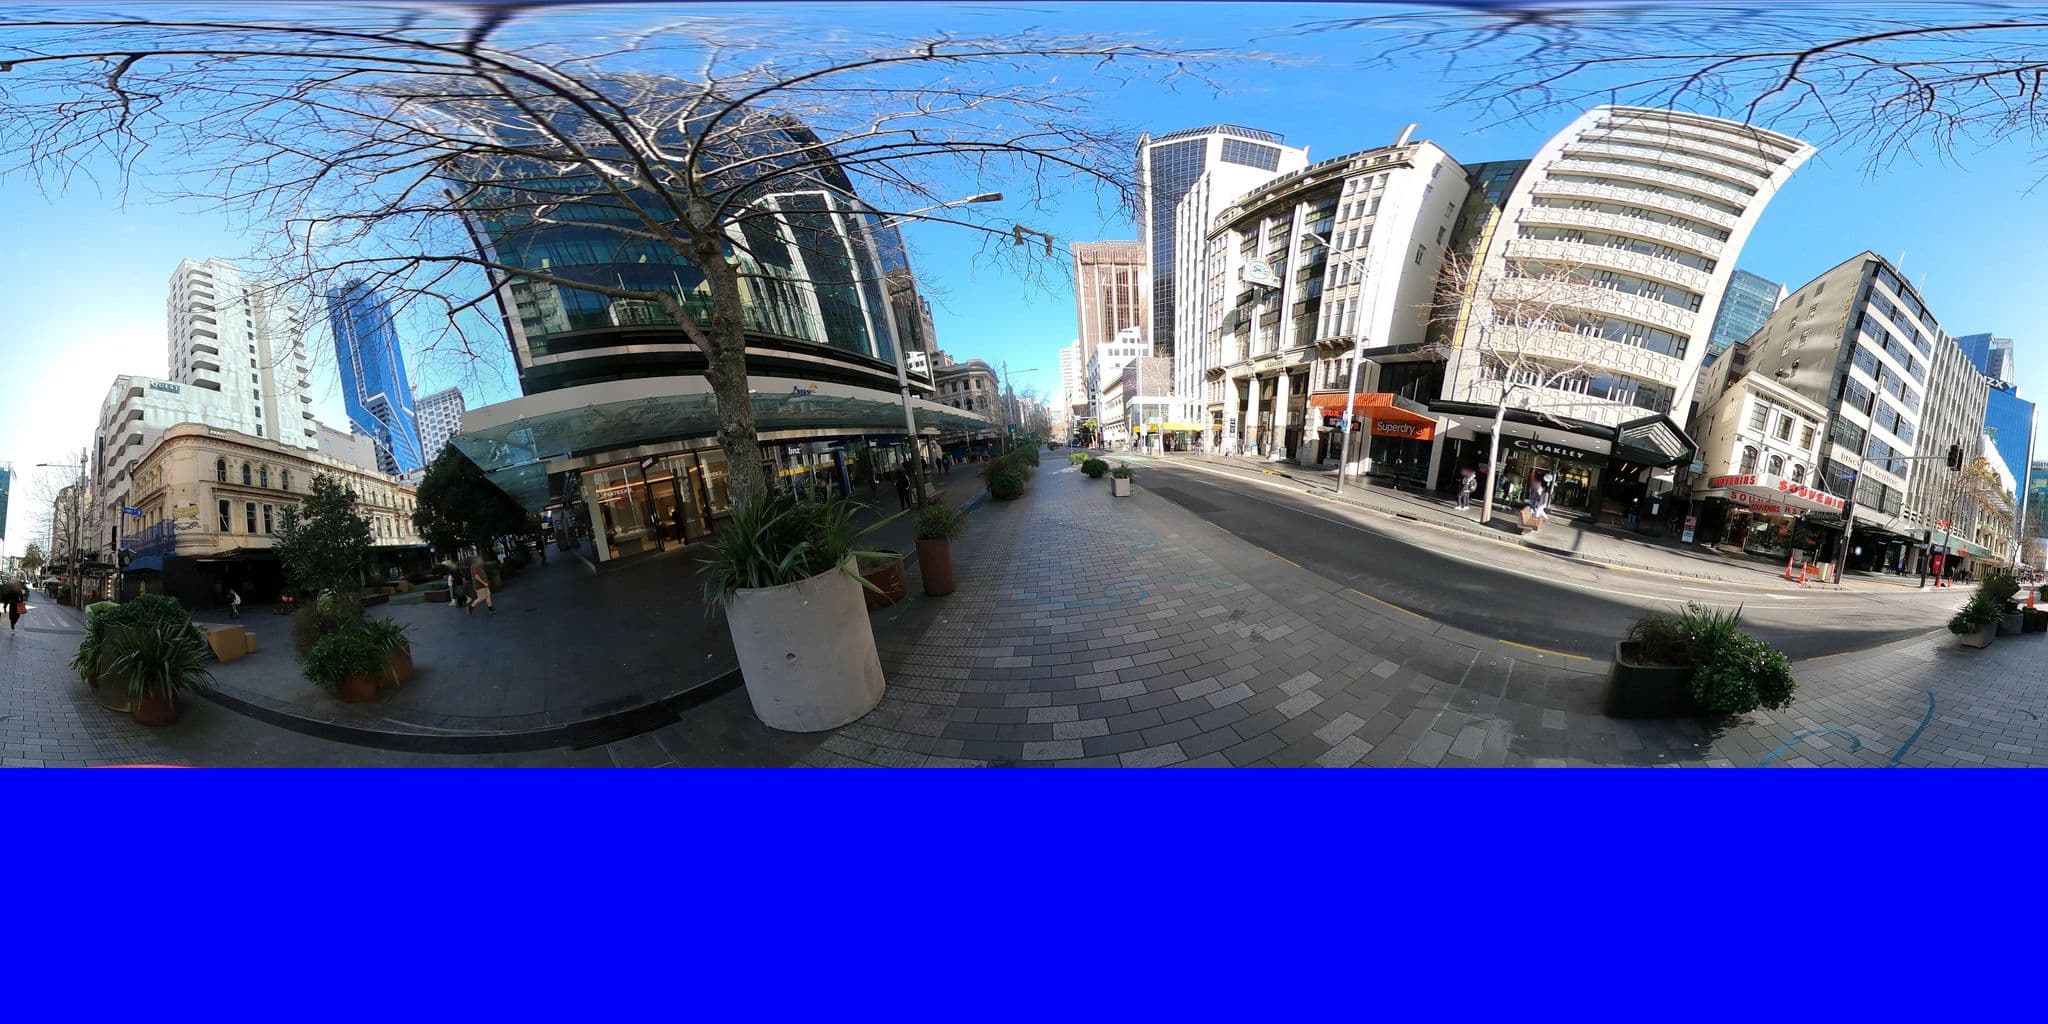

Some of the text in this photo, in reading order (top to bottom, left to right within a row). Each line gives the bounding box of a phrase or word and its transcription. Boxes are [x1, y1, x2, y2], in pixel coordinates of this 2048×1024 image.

[1985, 376, 2004, 389] ZX
[1377, 421, 1415, 435] Superdry
[1537, 444, 1584, 458] OAKLEY
[1778, 480, 1844, 510] SOUVENIR
